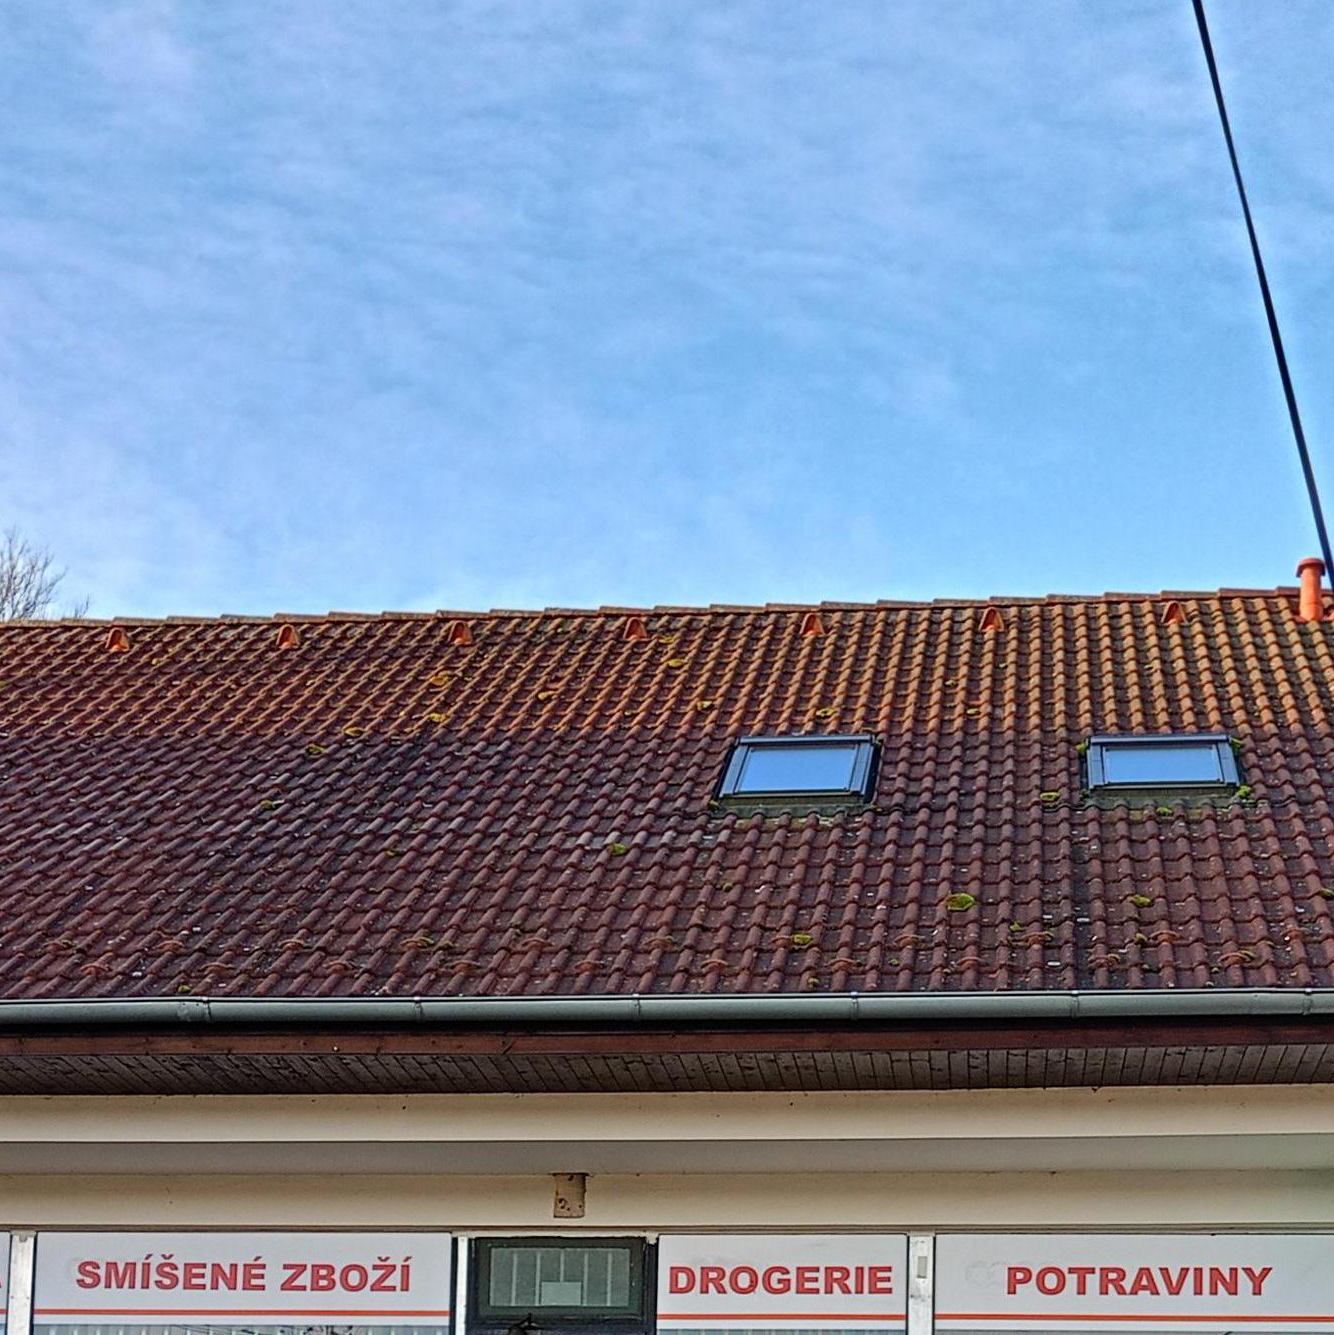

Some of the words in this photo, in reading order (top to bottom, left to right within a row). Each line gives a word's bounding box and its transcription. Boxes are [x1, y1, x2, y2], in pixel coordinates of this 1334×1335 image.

[76, 1253, 267, 1290] SMÍŠENÉ
[280, 1255, 413, 1292] ZBOŽÍ
[668, 1264, 894, 1296] DROGERIE
[1006, 1265, 1273, 1296] POTRAVINY
